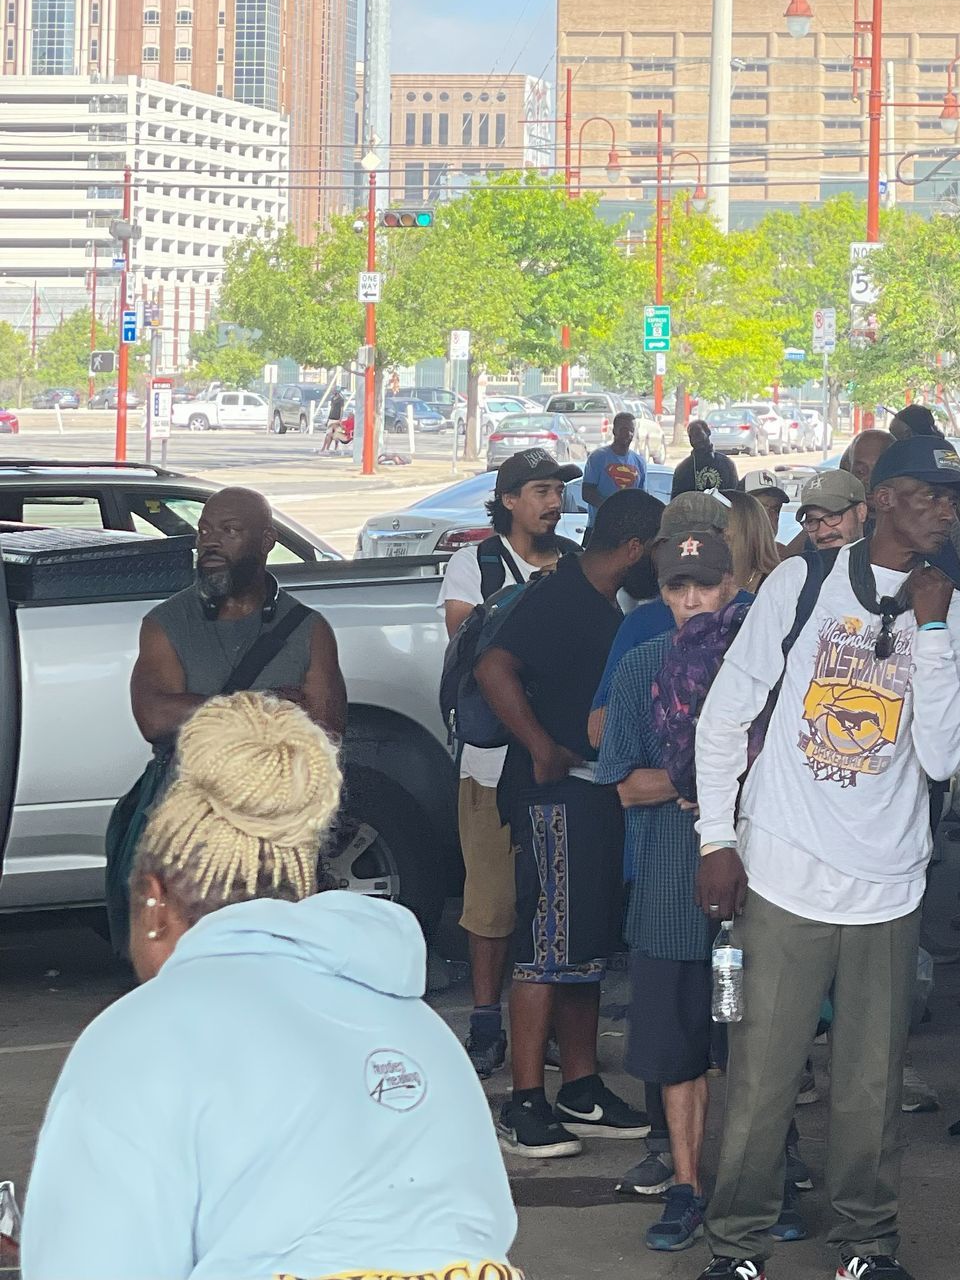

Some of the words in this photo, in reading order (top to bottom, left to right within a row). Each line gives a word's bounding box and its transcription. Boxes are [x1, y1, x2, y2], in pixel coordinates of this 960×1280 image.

[361, 283, 378, 291] WAY
[681, 540, 700, 556] H
[893, 629, 912, 656] est
